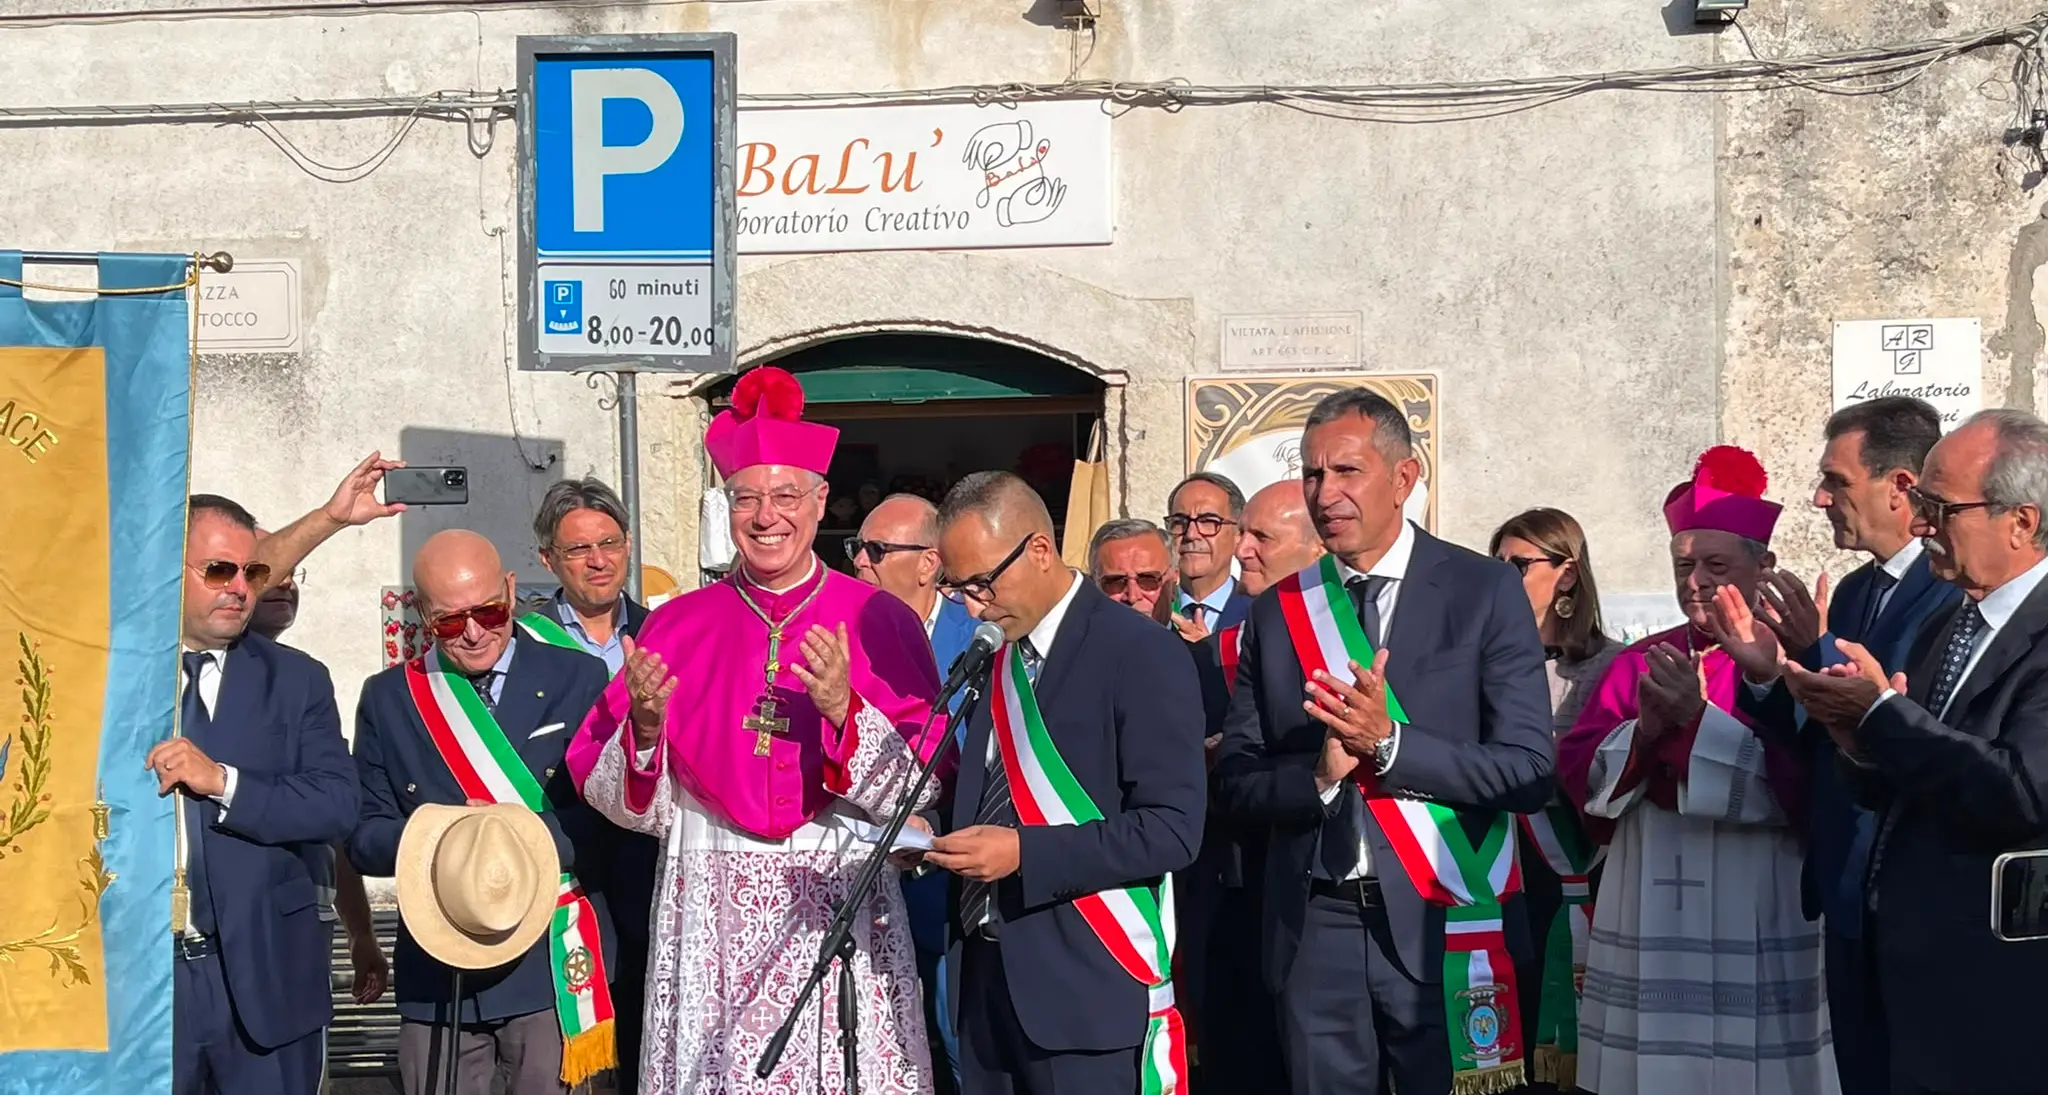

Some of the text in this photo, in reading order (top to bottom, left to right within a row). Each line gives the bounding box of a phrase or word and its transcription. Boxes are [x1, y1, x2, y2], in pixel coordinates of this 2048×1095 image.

[571, 68, 685, 232] P
[865, 204, 970, 233] Creativo
[199, 285, 239, 300] ZZA
[557, 287, 569, 301] P
[609, 278, 699, 300] 60 minuti
[199, 312, 258, 327] TOCCO
[1230, 327, 1276, 337] VIETATA
[1846, 380, 1970, 400] Laboratorio
